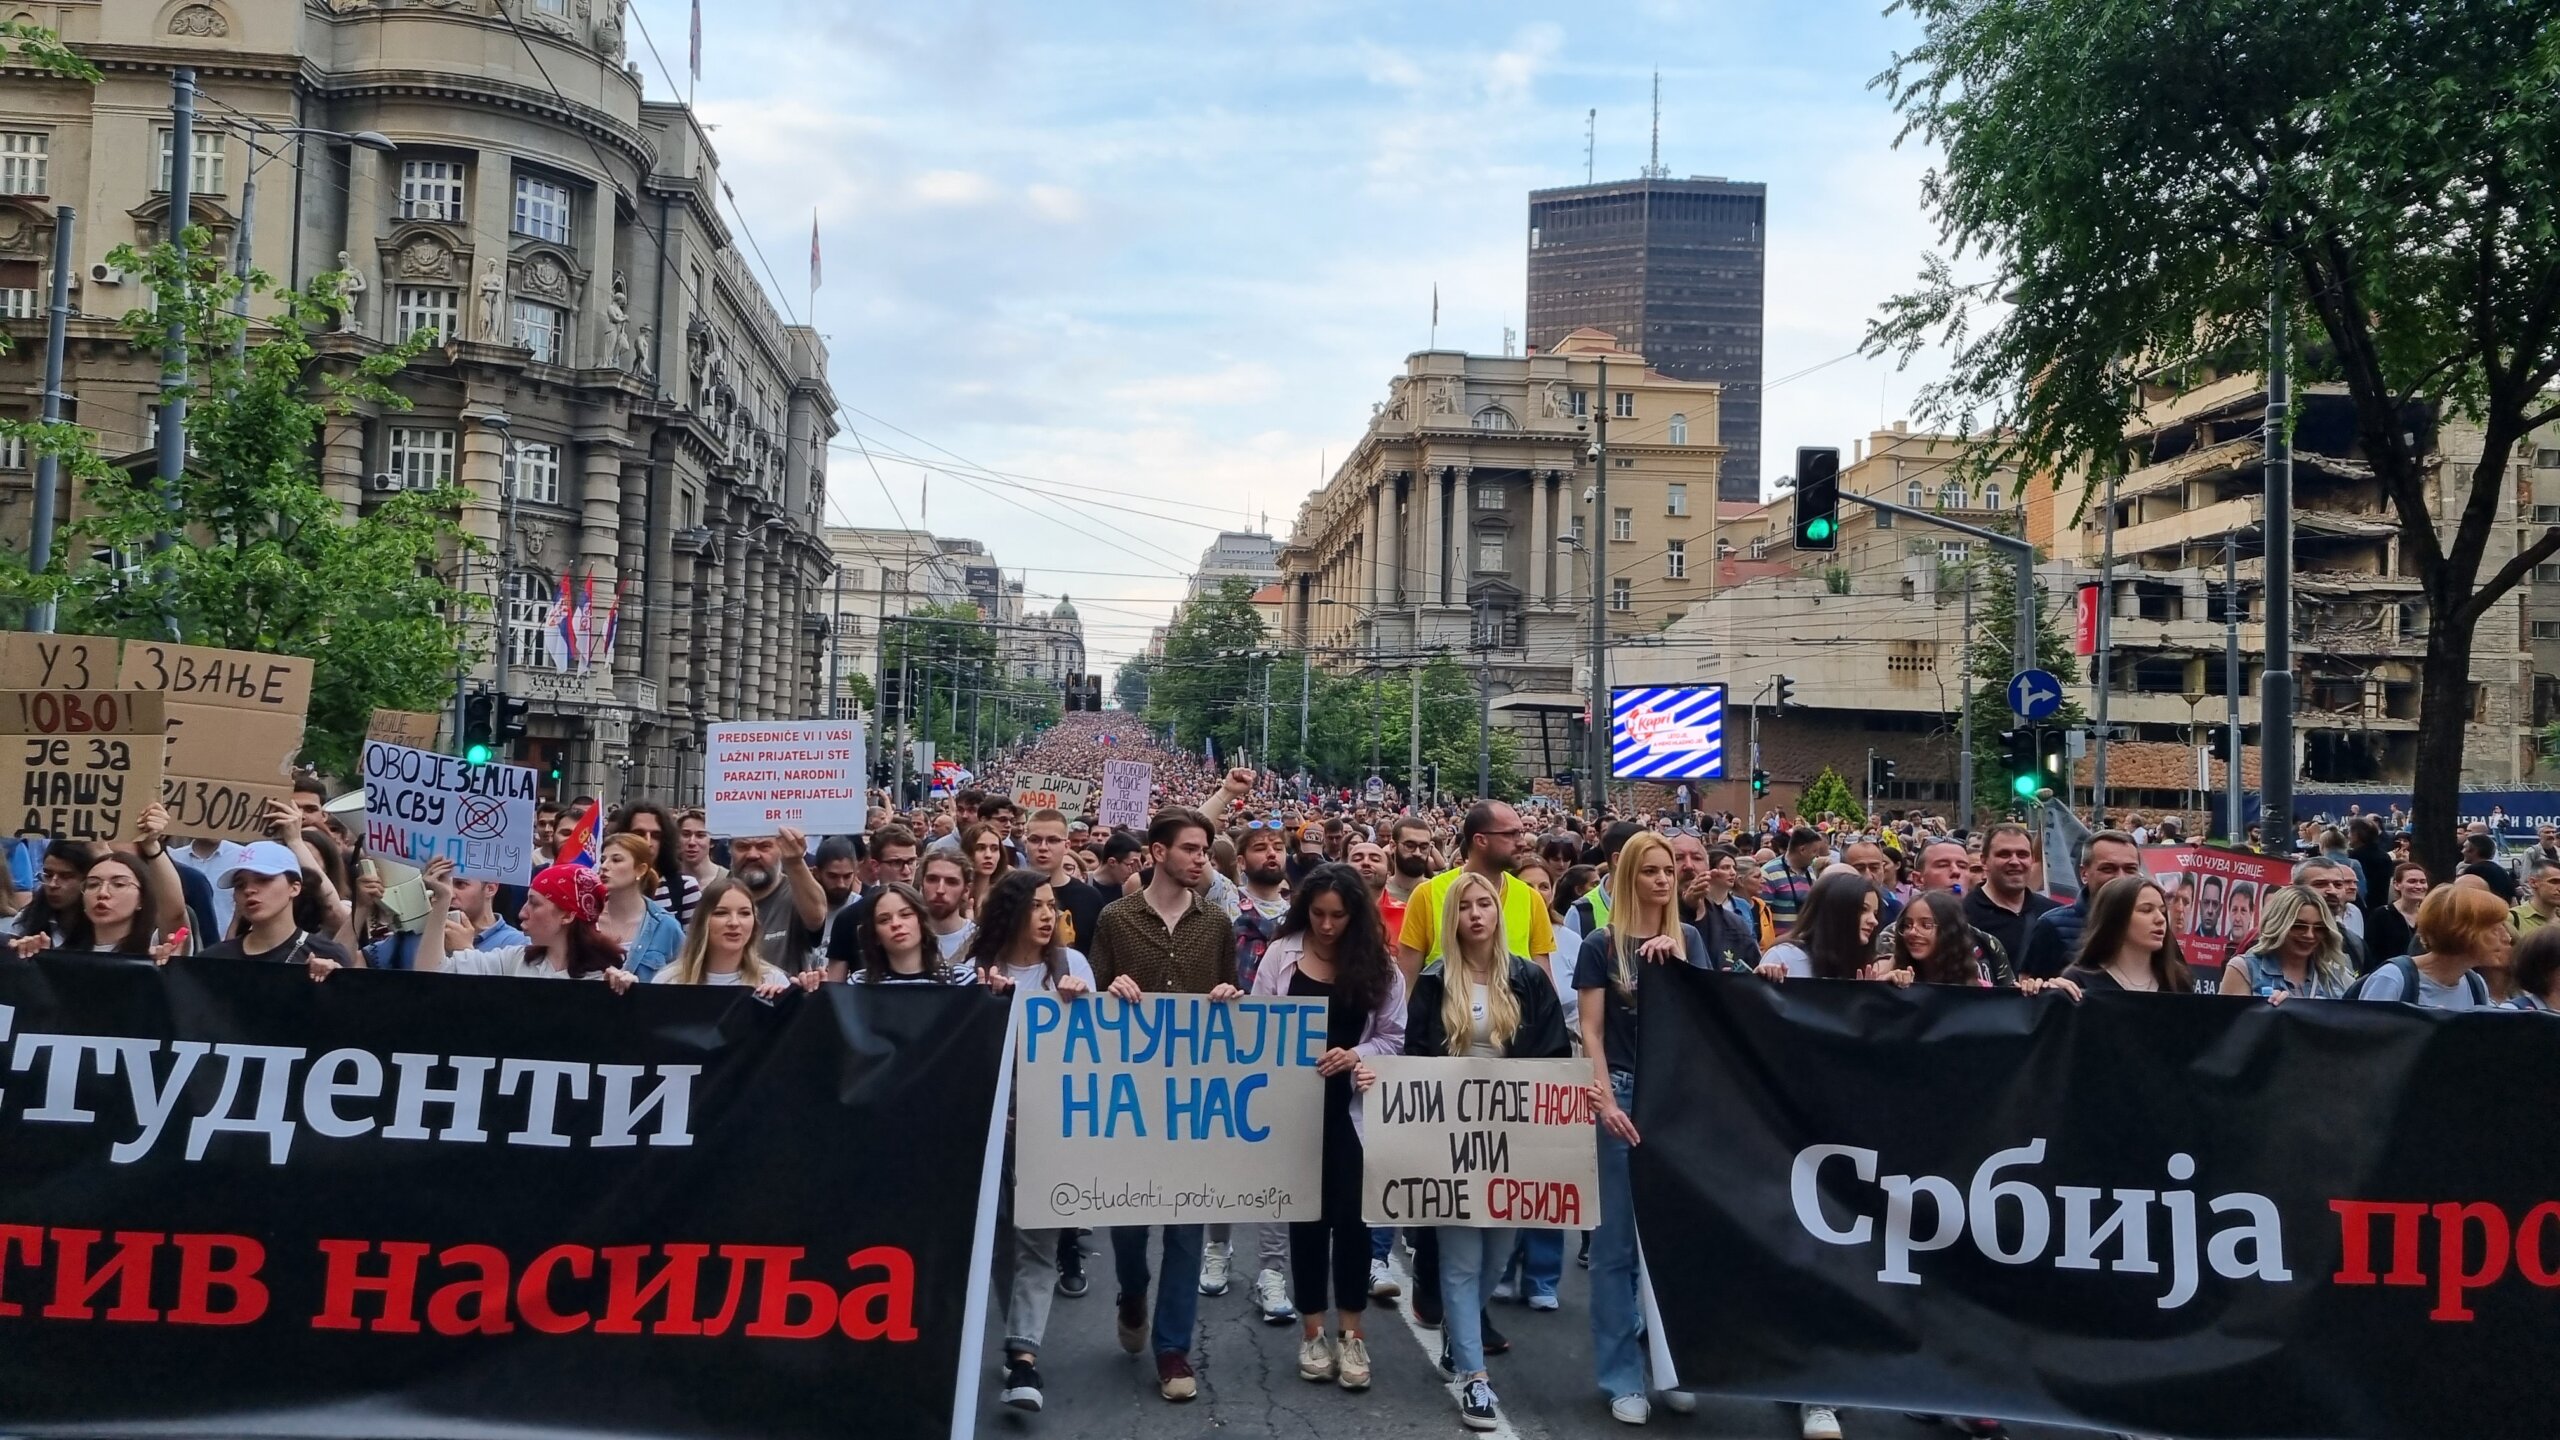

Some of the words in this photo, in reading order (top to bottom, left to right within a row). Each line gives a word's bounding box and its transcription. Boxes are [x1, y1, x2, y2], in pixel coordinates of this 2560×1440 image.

[134, 647, 291, 704] ЗВАЊЕ
[803, 731, 814, 741] VI
[826, 729, 852, 741] VAŠI
[1638, 713, 1671, 731] Kapri
[366, 743, 421, 784] ОВО
[422, 755, 454, 791] ЈЕ
[454, 760, 535, 801] ЗЕМЉА
[720, 750, 754, 763] LAŽNI
[758, 750, 824, 762] PRIJATELJI
[827, 749, 850, 760] STE
[1107, 760, 1151, 779] ОСЛОБОДИ
[23, 771, 124, 806] НАШУ
[723, 770, 781, 783] PARAZITI,
[784, 769, 837, 781] NARODNI
[1016, 775, 1033, 789] НЕ
[1040, 777, 1082, 796] ДИРАЈ
[1112, 776, 1142, 792] МЕДИЈЕ
[366, 783, 393, 817] ЗА
[396, 789, 445, 826] СВУ
[715, 789, 767, 802] DRŽAVNI
[770, 788, 853, 801] NEPRIJATELJI
[1018, 790, 1056, 809] ЛАВА
[14, 807, 121, 841] ДЕЦУ
[765, 809, 781, 820] BR
[1108, 811, 1139, 828] ИЗБОРЕ
[368, 819, 436, 863] НАШУ
[447, 837, 520, 877] ДЕЦУ
[2204, 857, 2231, 873] ЧУВА
[1026, 997, 1327, 1067] РАЧУНАЈТЕ
[0, 1005, 702, 1165] туденти
[1382, 1080, 1445, 1124] ИЛИ
[1457, 1079, 1529, 1122] СТАЈЕ
[1062, 1073, 1147, 1138] НА
[1165, 1073, 1271, 1142] НАС
[1449, 1130, 1509, 1174] ИЛИ
[1382, 1177, 1470, 1220] СТАЈЕ
[1487, 1178, 1579, 1225] СРБИЈА
[1790, 1138, 2293, 1309] Србија
[312, 1240, 918, 1342] насиља
